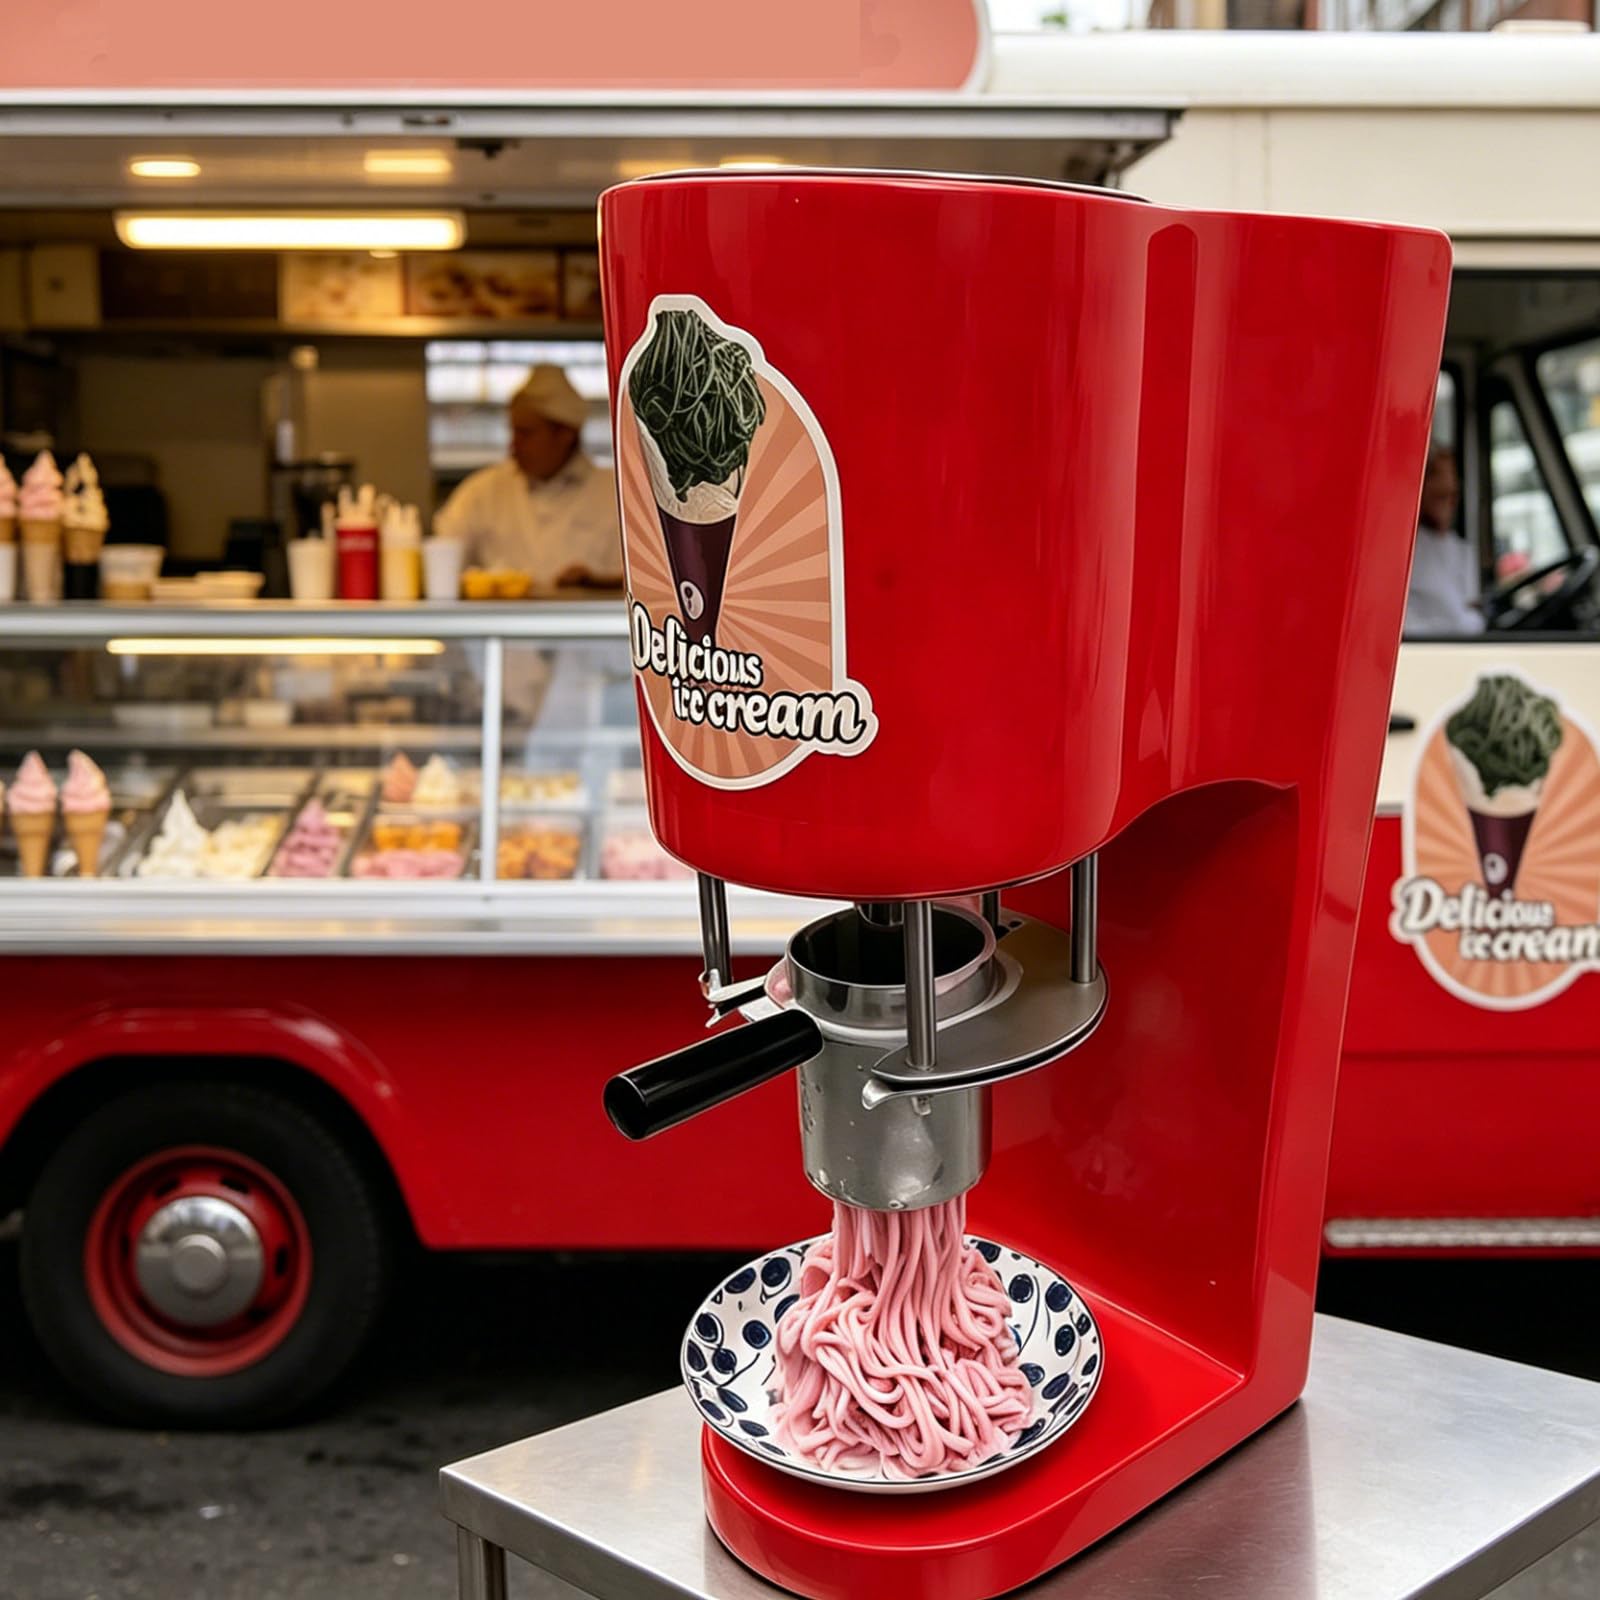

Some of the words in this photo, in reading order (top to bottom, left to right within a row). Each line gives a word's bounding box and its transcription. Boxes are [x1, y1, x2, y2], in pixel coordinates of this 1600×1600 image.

[629, 602, 762, 686] Delicious
[706, 691, 867, 742] cream
[1401, 877, 1554, 932] Delicious
